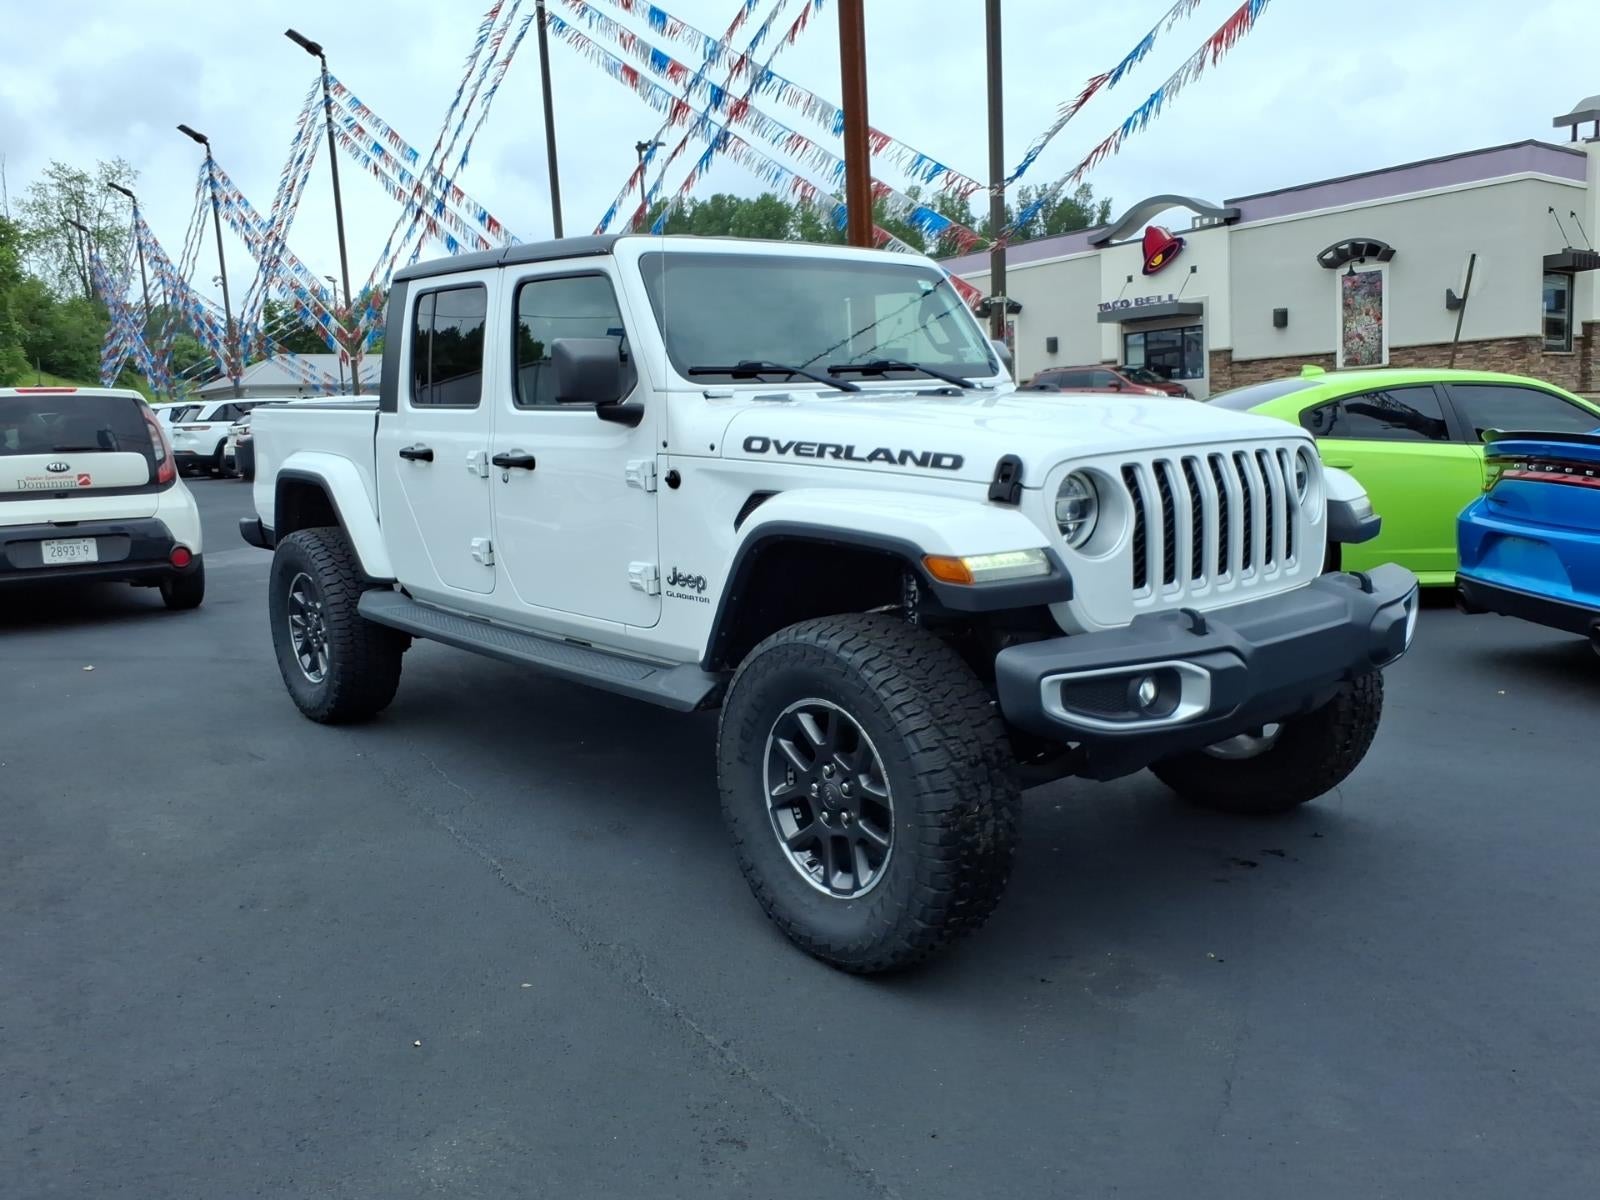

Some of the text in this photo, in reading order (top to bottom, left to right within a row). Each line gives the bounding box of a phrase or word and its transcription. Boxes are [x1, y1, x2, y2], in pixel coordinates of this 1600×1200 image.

[1098, 294, 1178, 312] TACO BELL
[742, 436, 965, 471] OVERLAND
[49, 463, 67, 472] KIA
[17, 479, 78, 490] Dominion
[667, 566, 707, 594] Jeep
[666, 590, 710, 604] GLADIATOR
